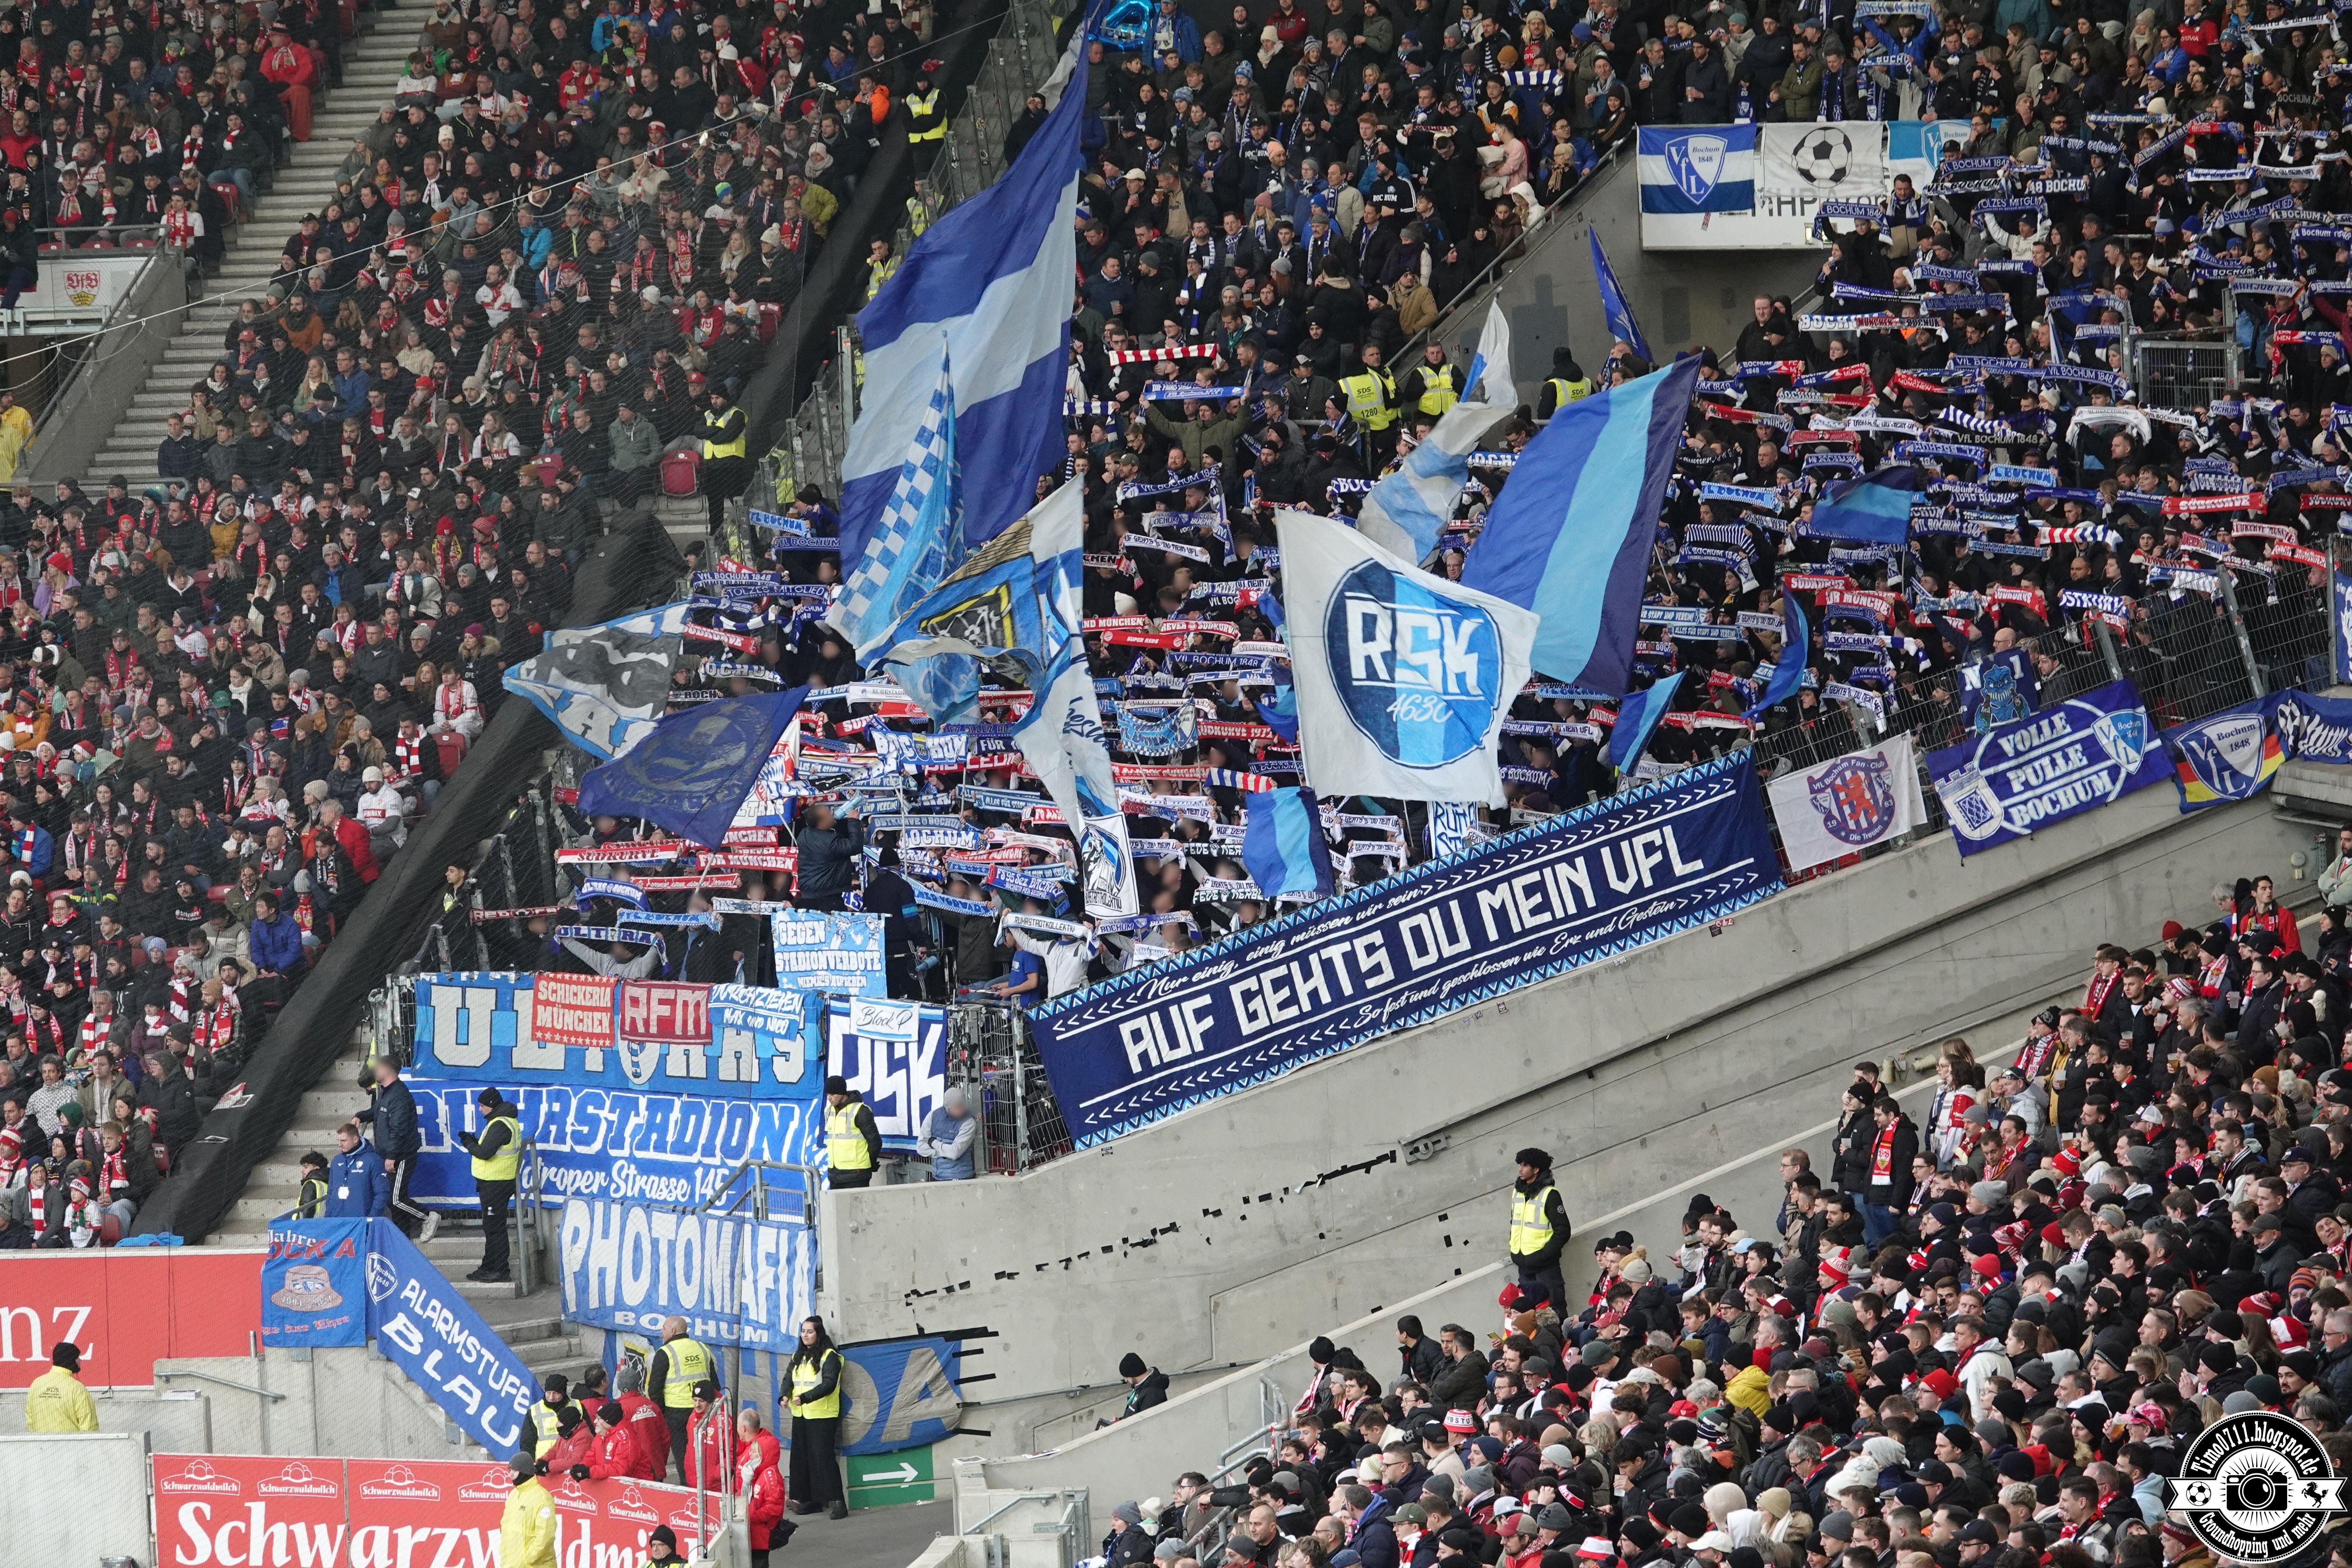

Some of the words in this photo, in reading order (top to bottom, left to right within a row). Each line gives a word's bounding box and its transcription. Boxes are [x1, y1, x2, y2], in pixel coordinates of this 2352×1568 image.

[1944, 131, 1968, 139] Bochum
[1692, 145, 1720, 154] Bochum
[1698, 155, 1713, 163] 1848
[1953, 159, 1991, 171] BOCHUM
[1668, 146, 1705, 196] VfL
[1948, 178, 2003, 192] BOCHUM
[1830, 205, 1865, 216] BOCHUM
[2224, 208, 2257, 220] STOLZES
[2258, 199, 2294, 216] MITGLIED
[2282, 211, 2320, 219] BOCHUM
[1923, 265, 1952, 278] STOLZES
[1988, 263, 2002, 271] FANS
[2002, 263, 2014, 271] VOM
[1955, 357, 1969, 365] VfL
[1971, 357, 2012, 368] BOCHUM
[2048, 365, 2059, 376] VfL
[2061, 365, 2095, 380] BOCHUM
[2096, 371, 2114, 383] 1848
[1357, 386, 1372, 395] SDS
[1361, 407, 1378, 418] 1280
[2156, 413, 2180, 423] BOCHUM
[1957, 434, 1973, 443] VfL
[1975, 434, 2015, 444] BOCHUM
[2016, 434, 2038, 444] 1848
[1140, 481, 1157, 493] VfL
[1158, 472, 1200, 490] BOCHUM
[1718, 484, 1765, 502] BOCHUM
[2179, 496, 2251, 511] SÜDKURVE
[1930, 518, 1960, 533] BOCHUM
[790, 538, 841, 547] BOCHUM
[1133, 536, 1154, 545] GEHTS
[1172, 542, 1187, 552] MEIN
[1692, 546, 1723, 557] BOCHUM
[751, 573, 772, 581] 1848
[725, 586, 770, 598] STOLZES
[774, 585, 824, 595] MITGLIED
[1209, 597, 1222, 606] VfL
[1098, 617, 1143, 628] MÜNCHEN
[1646, 610, 1663, 620] STADT
[1664, 611, 1677, 621] UND
[1674, 626, 1687, 635] ALLES
[1687, 627, 1696, 636] FÜR
[1696, 627, 1710, 636] STADT
[1710, 627, 1719, 637] UND
[1344, 599, 1483, 695] RSK
[1834, 636, 1875, 646] BOCHUM
[1174, 654, 1187, 662] VfL
[1192, 655, 1237, 666] BOCHUM
[1238, 657, 1258, 667] 1848
[1140, 675, 1184, 688] BOCHUM
[1246, 674, 1265, 684] VfL
[1961, 664, 1982, 692] N
[1197, 721, 1247, 737] SÜDKURVE
[1250, 726, 1273, 738] 1972
[1579, 726, 1593, 735] VFL
[2117, 719, 2141, 730] Bochum
[1997, 711, 2072, 758] VOLLE
[2217, 723, 2256, 742] Bochum
[875, 732, 968, 763] BOCHUM
[980, 738, 1006, 751] FÜR
[2229, 738, 2251, 754] 1848
[2006, 743, 2089, 793] PULLE
[2189, 738, 2246, 794] VfL
[1508, 768, 1548, 786] BOCHUM
[1812, 779, 1827, 792] VfL
[1824, 761, 1849, 786] Bochum
[1884, 799, 1893, 808] 83
[2009, 771, 2114, 827] BOCHUM
[1827, 820, 1838, 828] 19
[1849, 832, 1861, 841] Die
[1861, 824, 1883, 839] Treuen
[1185, 844, 1209, 855] FEDE
[729, 854, 795, 870] MÜNCHEN
[1193, 891, 1218, 903] FEDE
[1014, 916, 1075, 932] RUHRSTADTKOLLEKTIV
[1100, 923, 1134, 934] BOCHUM
[778, 920, 826, 947] GEGEN
[1119, 994, 1216, 1074] AUF
[1229, 929, 1395, 1036] GEHTS
[1400, 898, 1472, 971] DU
[1476, 855, 1596, 942] MEIN
[1605, 825, 1704, 895] VFL
[1137, 975, 1190, 1000] Nur
[1192, 959, 1239, 983] einig,
[1246, 938, 1286, 961] einig
[1290, 915, 1353, 945] müssen
[1356, 903, 1385, 922] wir
[775, 949, 882, 973] STADIONVERBOTE
[1355, 1005, 1382, 1028] So
[1383, 992, 1410, 1024] fest
[1410, 979, 1439, 1003] und
[1441, 955, 1521, 997] geschlossen
[1522, 945, 1546, 962] wie
[1549, 930, 1582, 956] Erz
[1585, 920, 1615, 943] und
[1618, 898, 1677, 932] Gestein
[537, 980, 610, 1007] SCHICKERIA
[711, 983, 804, 1013] DURCHZIEHEN
[625, 985, 708, 1035] RFM
[856, 1006, 891, 1026] Block
[536, 1004, 609, 1034] MÜNCHEN
[723, 1008, 745, 1026] MAX
[747, 1014, 764, 1029] UND
[766, 1016, 790, 1035] NICO
[611, 1160, 690, 1203] Strasse
[335, 1238, 356, 1259] A
[375, 1262, 397, 1284] Bochum
[560, 1198, 814, 1336] PHOTOMAFIA
[313, 1315, 349, 1330] Ehre
[400, 1278, 530, 1415] ALARMSTUFE
[685, 1355, 700, 1363] SDS
[381, 1311, 520, 1447] BLAU
[163, 1481, 238, 1492] Schwarzwaldmilch
[260, 1483, 335, 1494] Schwarzwaldmilch
[362, 1485, 438, 1497] Schwarzwaldmilch
[460, 1488, 509, 1499] Schwarzwal
[609, 1505, 658, 1522] Schwarzwaldmilch
